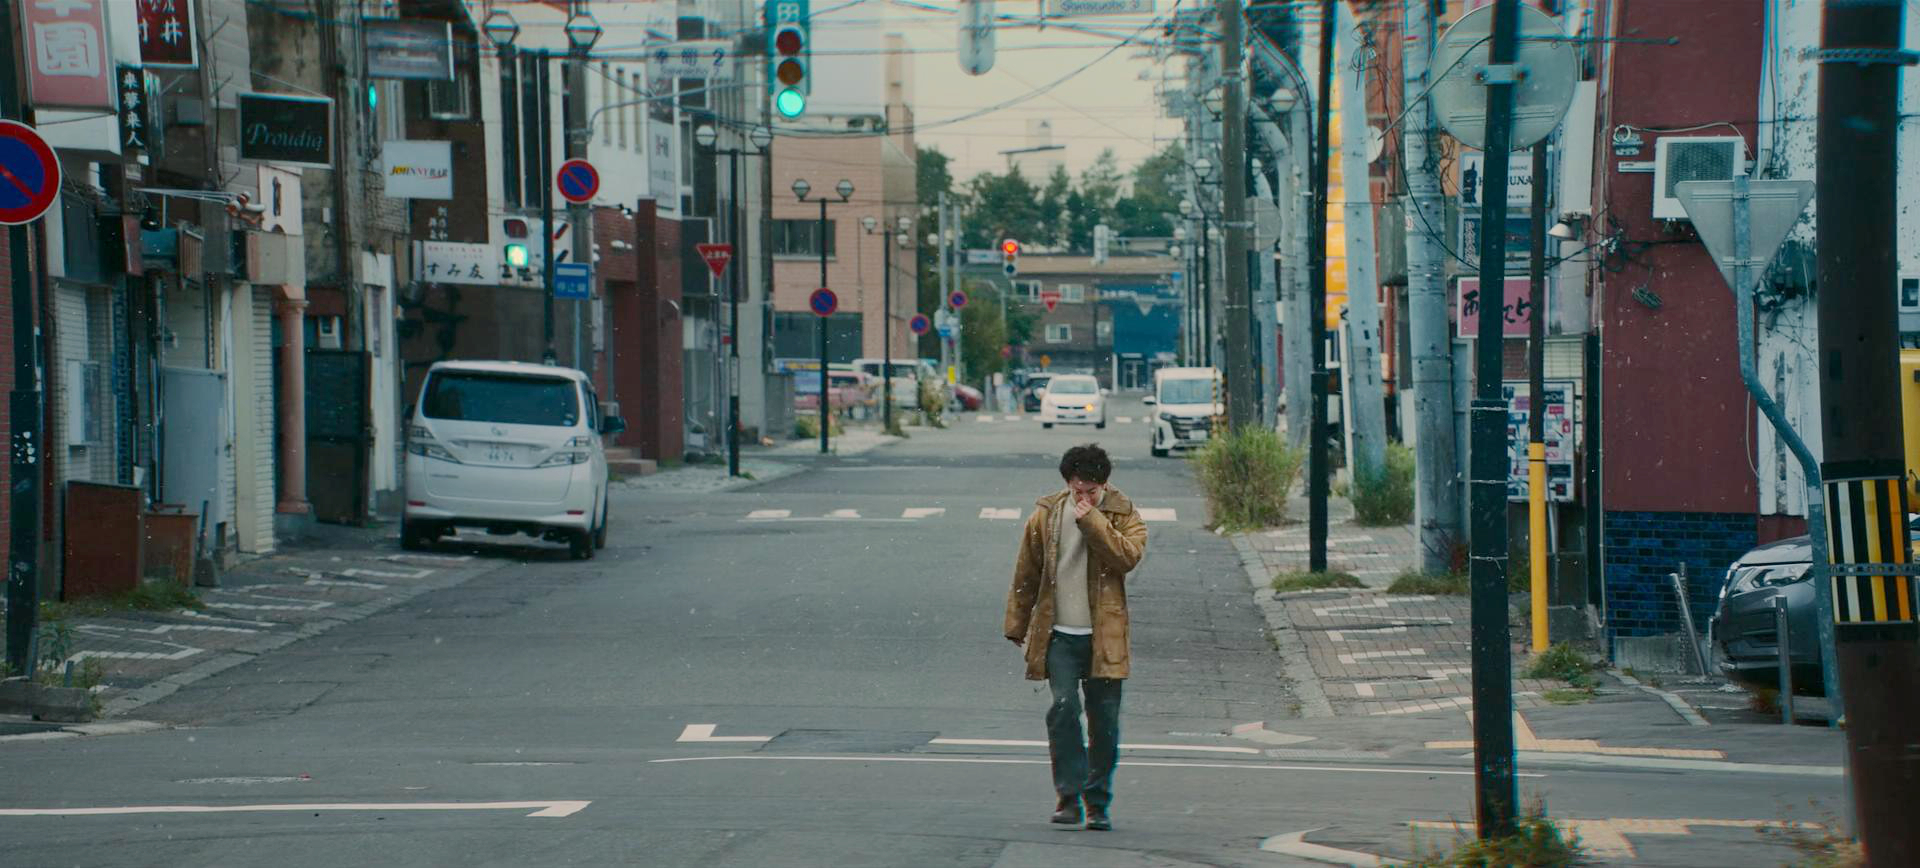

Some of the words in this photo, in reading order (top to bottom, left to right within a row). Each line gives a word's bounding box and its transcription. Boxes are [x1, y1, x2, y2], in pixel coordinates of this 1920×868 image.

[712, 47, 725, 67] 2
[389, 166, 430, 176] JOHNNY
[430, 167, 449, 178] BAR
